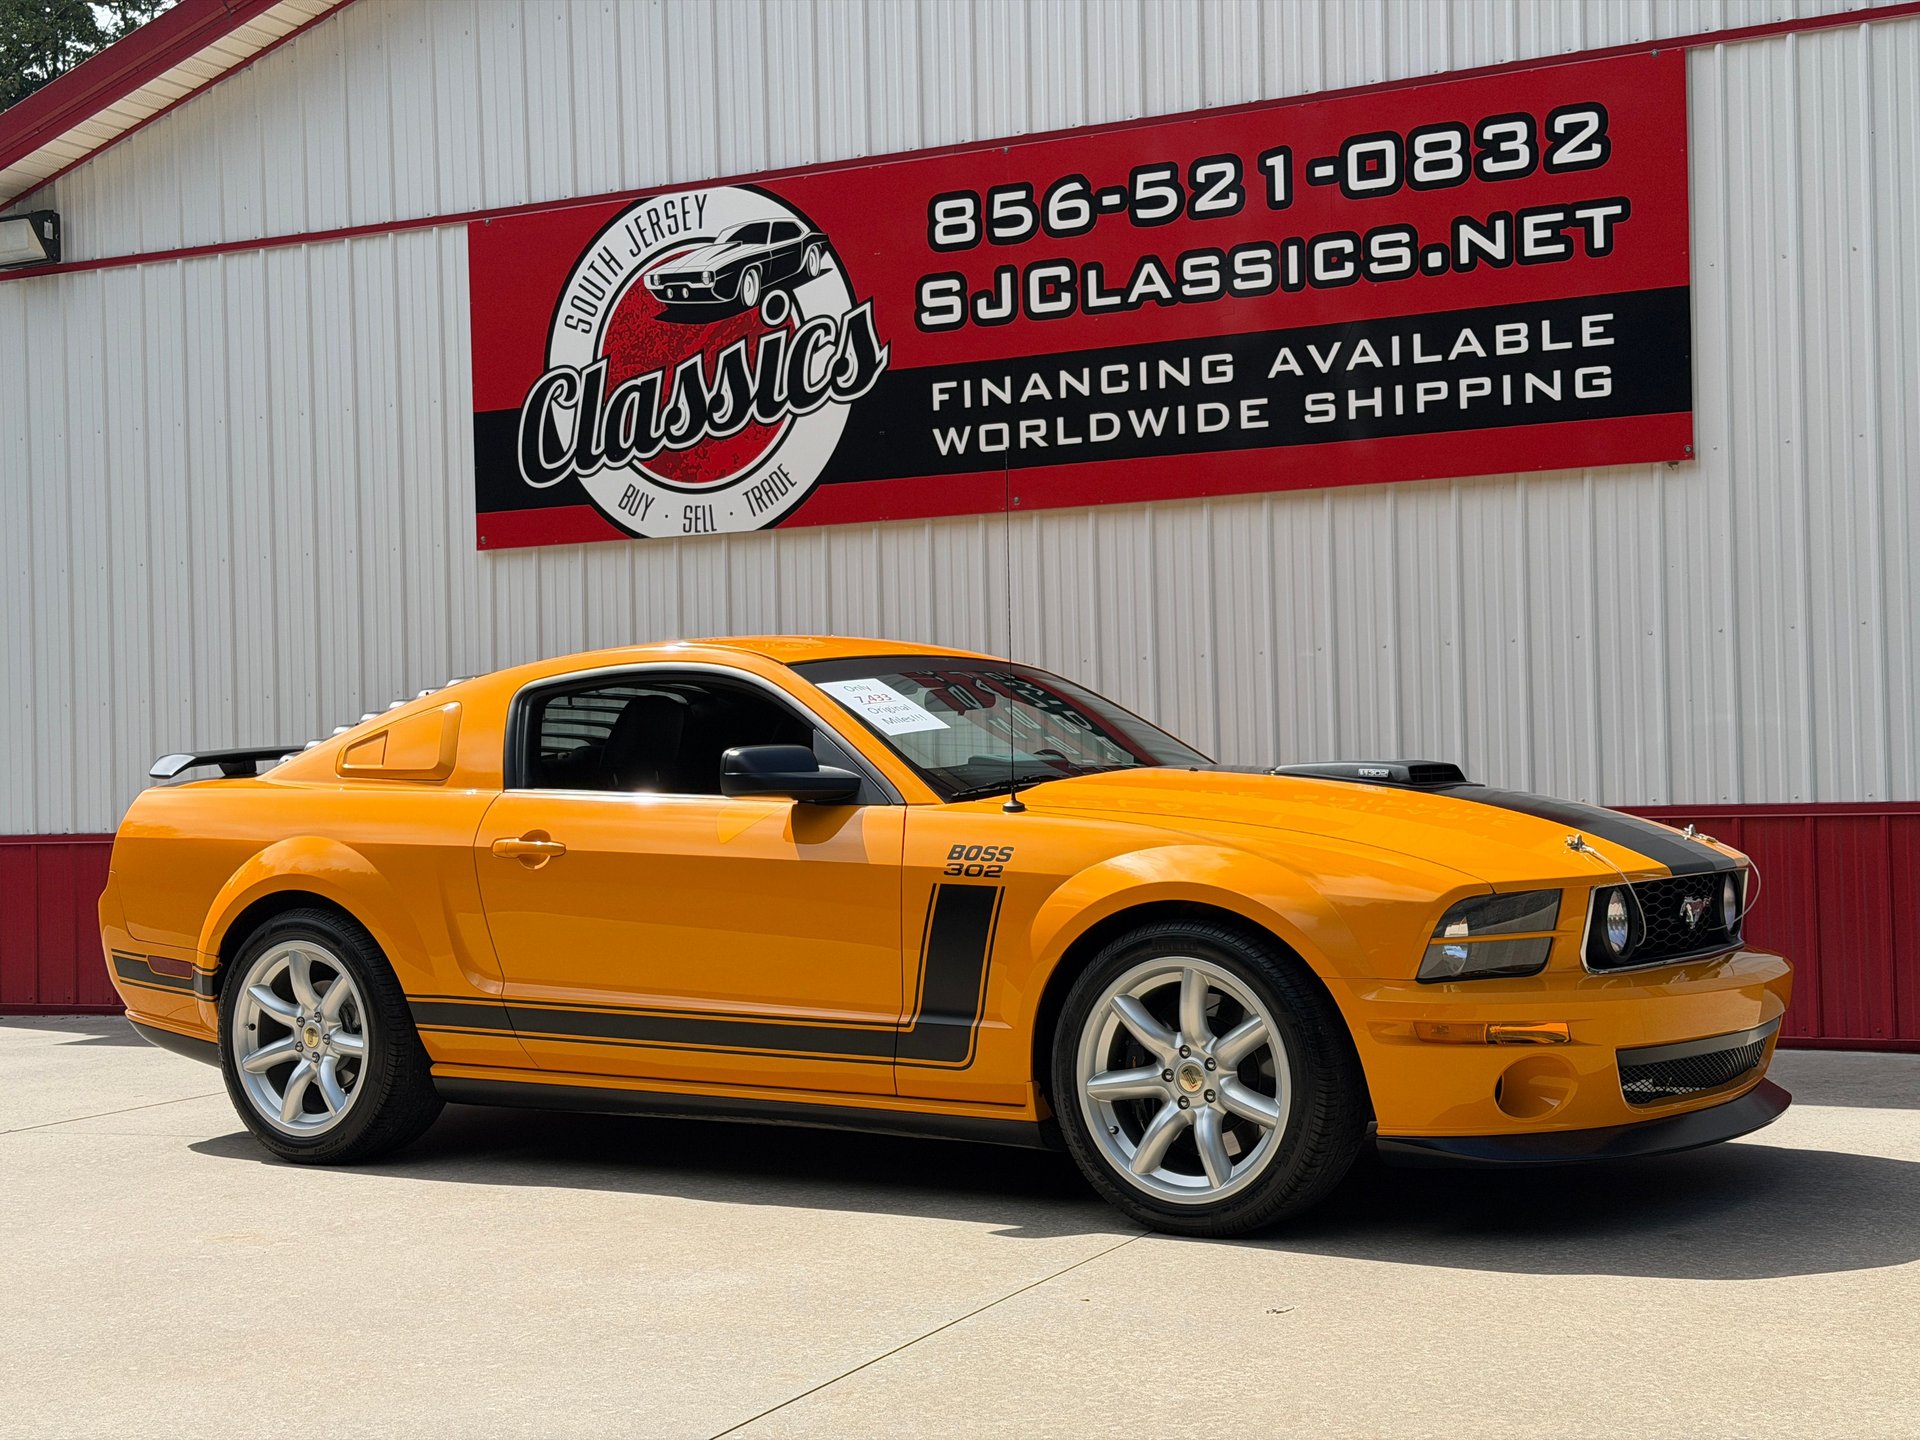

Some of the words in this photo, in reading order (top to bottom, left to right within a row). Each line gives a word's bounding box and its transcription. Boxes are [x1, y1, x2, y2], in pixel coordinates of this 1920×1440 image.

[933, 110, 1603, 247] 856-521-0832
[565, 245, 624, 334] SOUTH
[624, 193, 709, 258] JERSEY
[919, 204, 1624, 327] SJCLASSICS.NET
[518, 289, 890, 489] Classics
[932, 352, 1235, 411] FINANCING
[1267, 312, 1616, 378] AVAILABLE
[932, 397, 1270, 457] WORLDWIDE
[1303, 365, 1613, 425] SHIPPING
[618, 482, 656, 522] BUY
[682, 504, 718, 533] SELL
[742, 462, 798, 518] TRADE
[843, 684, 872, 693] Only
[867, 703, 912, 715] Original
[881, 713, 928, 726] Miles!!!
[944, 863, 1004, 878] 302
[947, 844, 1014, 862] BOSS
